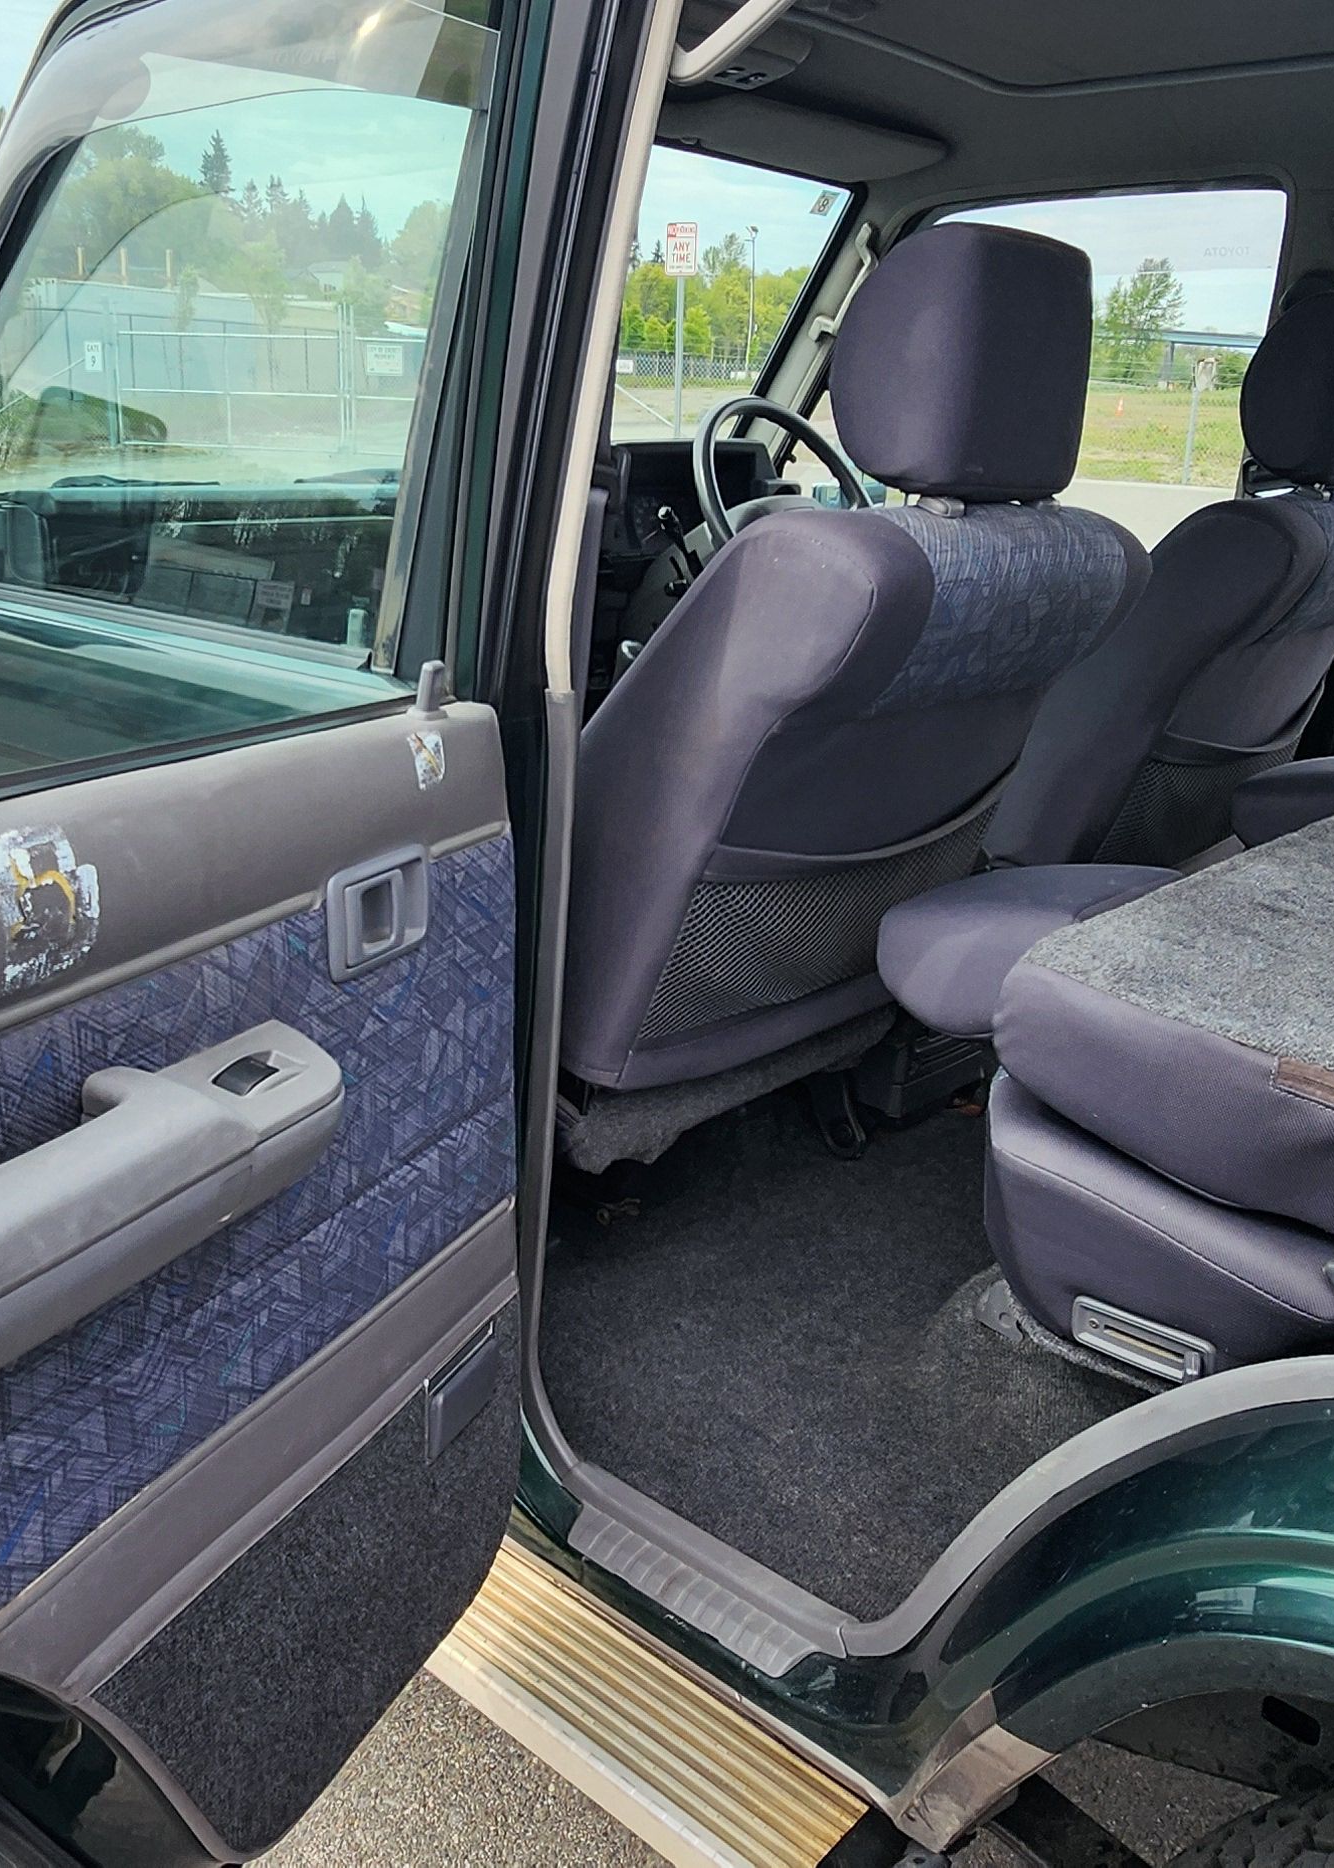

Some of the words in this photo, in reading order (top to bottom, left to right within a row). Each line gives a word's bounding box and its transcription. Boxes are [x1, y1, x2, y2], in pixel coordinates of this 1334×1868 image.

[818, 199, 829, 212] 8
[673, 241, 690, 251] ANY
[672, 253, 690, 263] TIME
[91, 355, 96, 367] 9
